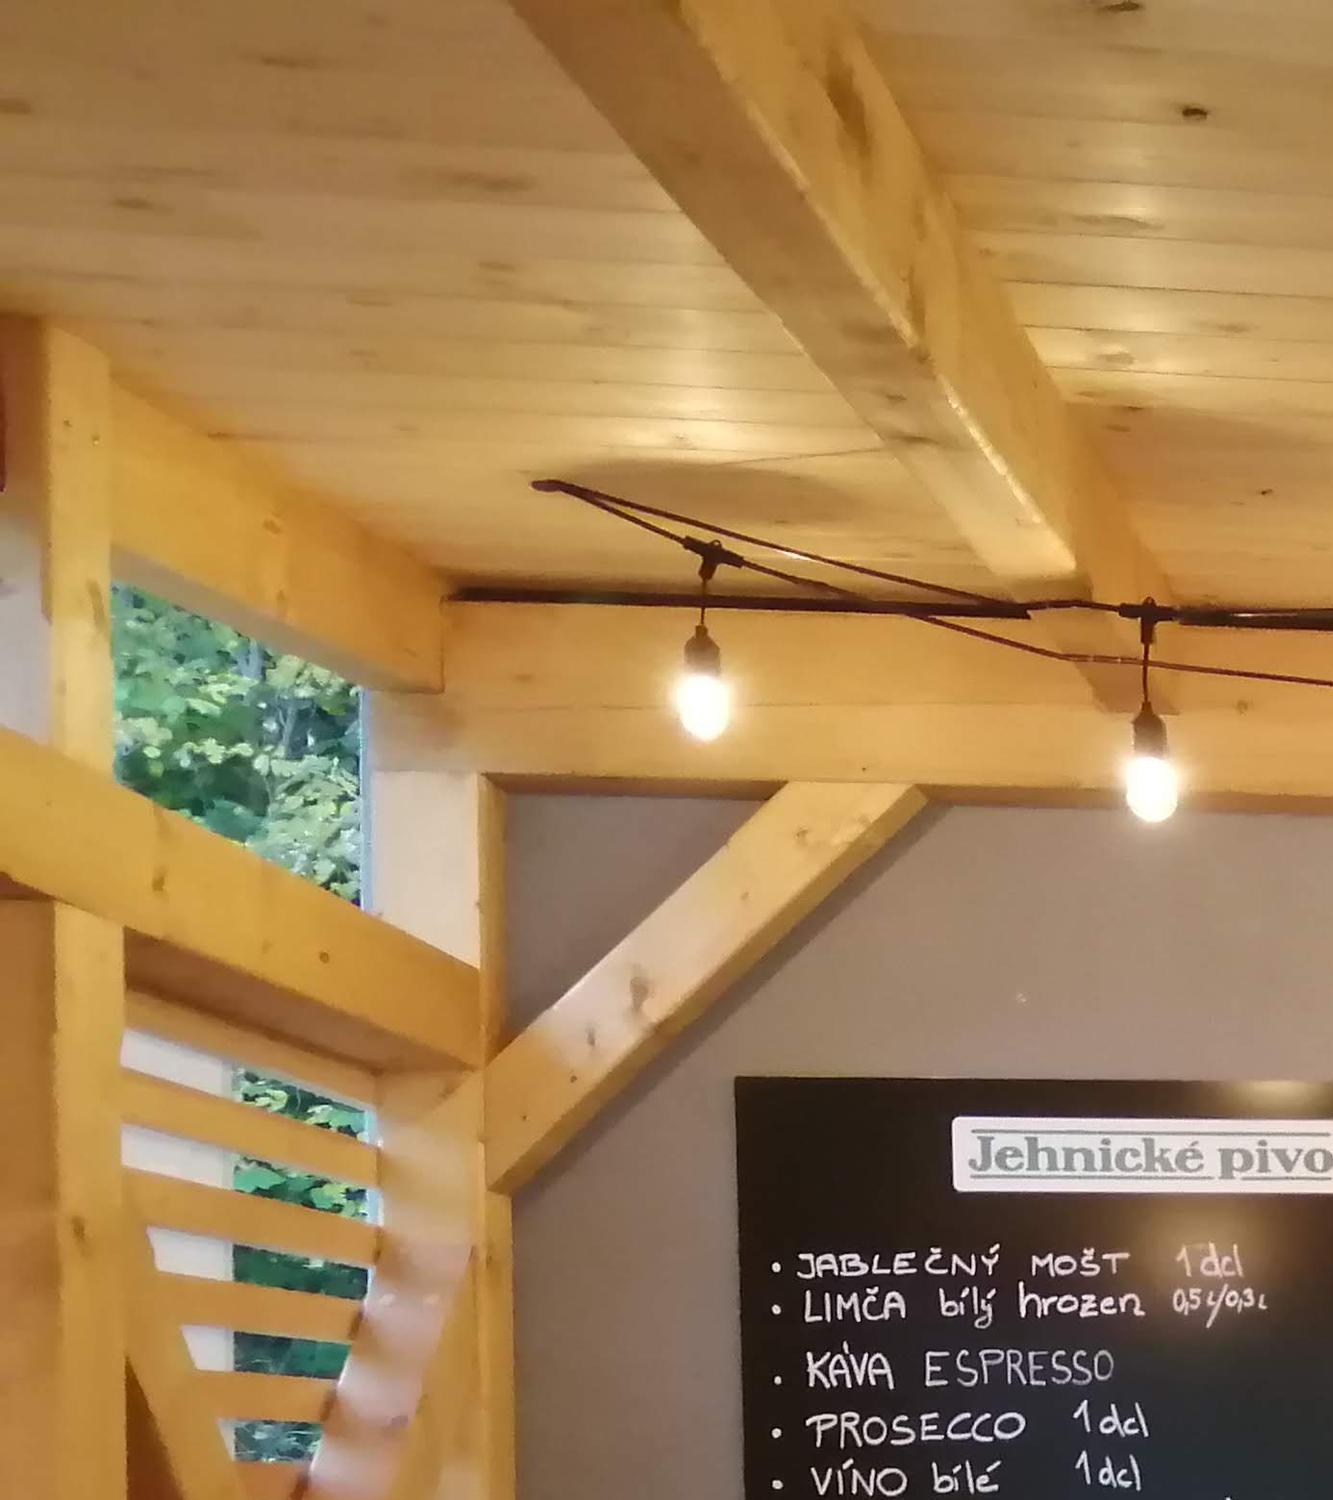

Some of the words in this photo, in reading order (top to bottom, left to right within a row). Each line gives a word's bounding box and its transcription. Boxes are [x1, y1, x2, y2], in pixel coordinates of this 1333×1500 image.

[968, 1135, 1204, 1176] Jehnické
[798, 1245, 1001, 1278] JABLEČNÝ
[1030, 1247, 1131, 1276] MOŠT
[804, 1287, 907, 1322] LIMČA
[939, 1290, 996, 1328] bílý
[1017, 1282, 1146, 1320] hrozen
[807, 1341, 896, 1391] KÁVA
[924, 1350, 1116, 1386] ESPRESSO
[806, 1411, 1028, 1447] PROSECCO
[809, 1459, 909, 1496] VÍNO
[931, 1458, 1001, 1495] bílé
